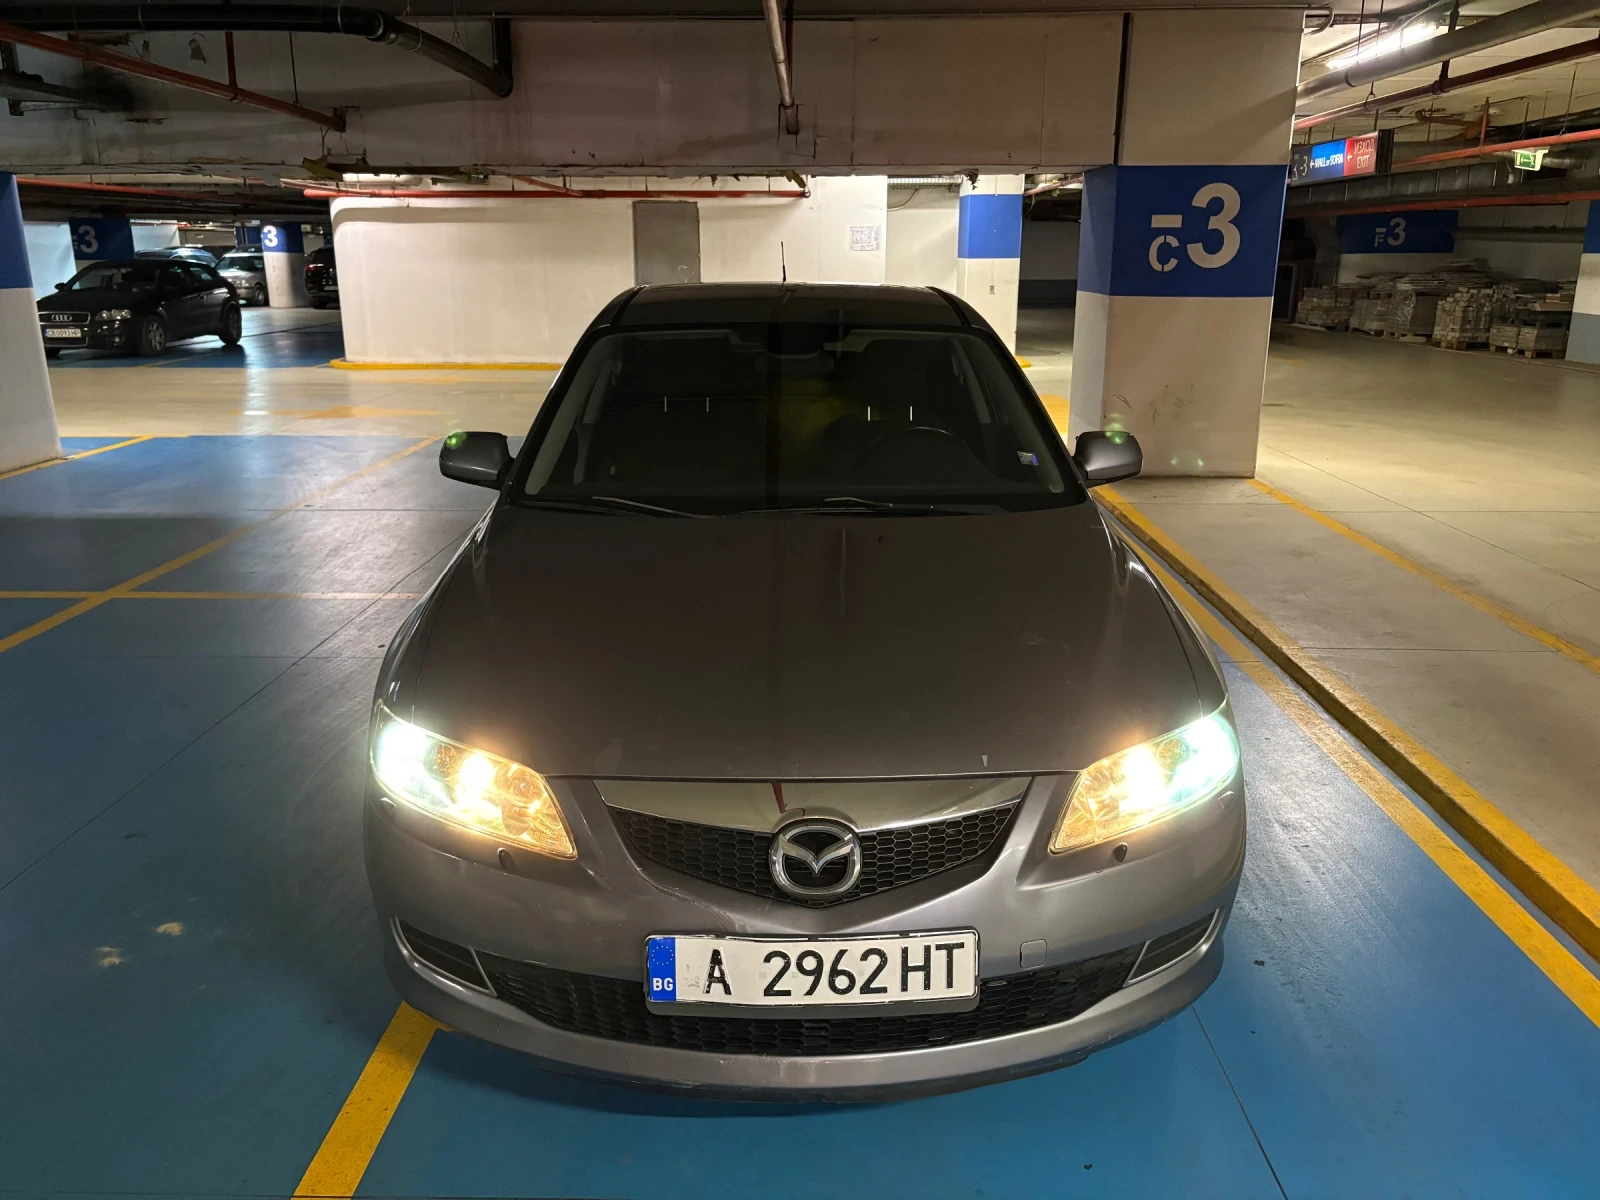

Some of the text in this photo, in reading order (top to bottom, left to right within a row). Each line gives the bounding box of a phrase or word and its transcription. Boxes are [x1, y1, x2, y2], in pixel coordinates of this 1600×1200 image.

[1354, 138, 1375, 154] ИЗХОД
[1329, 153, 1344, 165] SOFIA
[1356, 155, 1370, 169] EXIT
[263, 225, 279, 247] 3
[1374, 234, 1385, 247] F
[1148, 235, 1179, 272] C
[703, 948, 733, 996] A
[652, 977, 674, 992] BG
